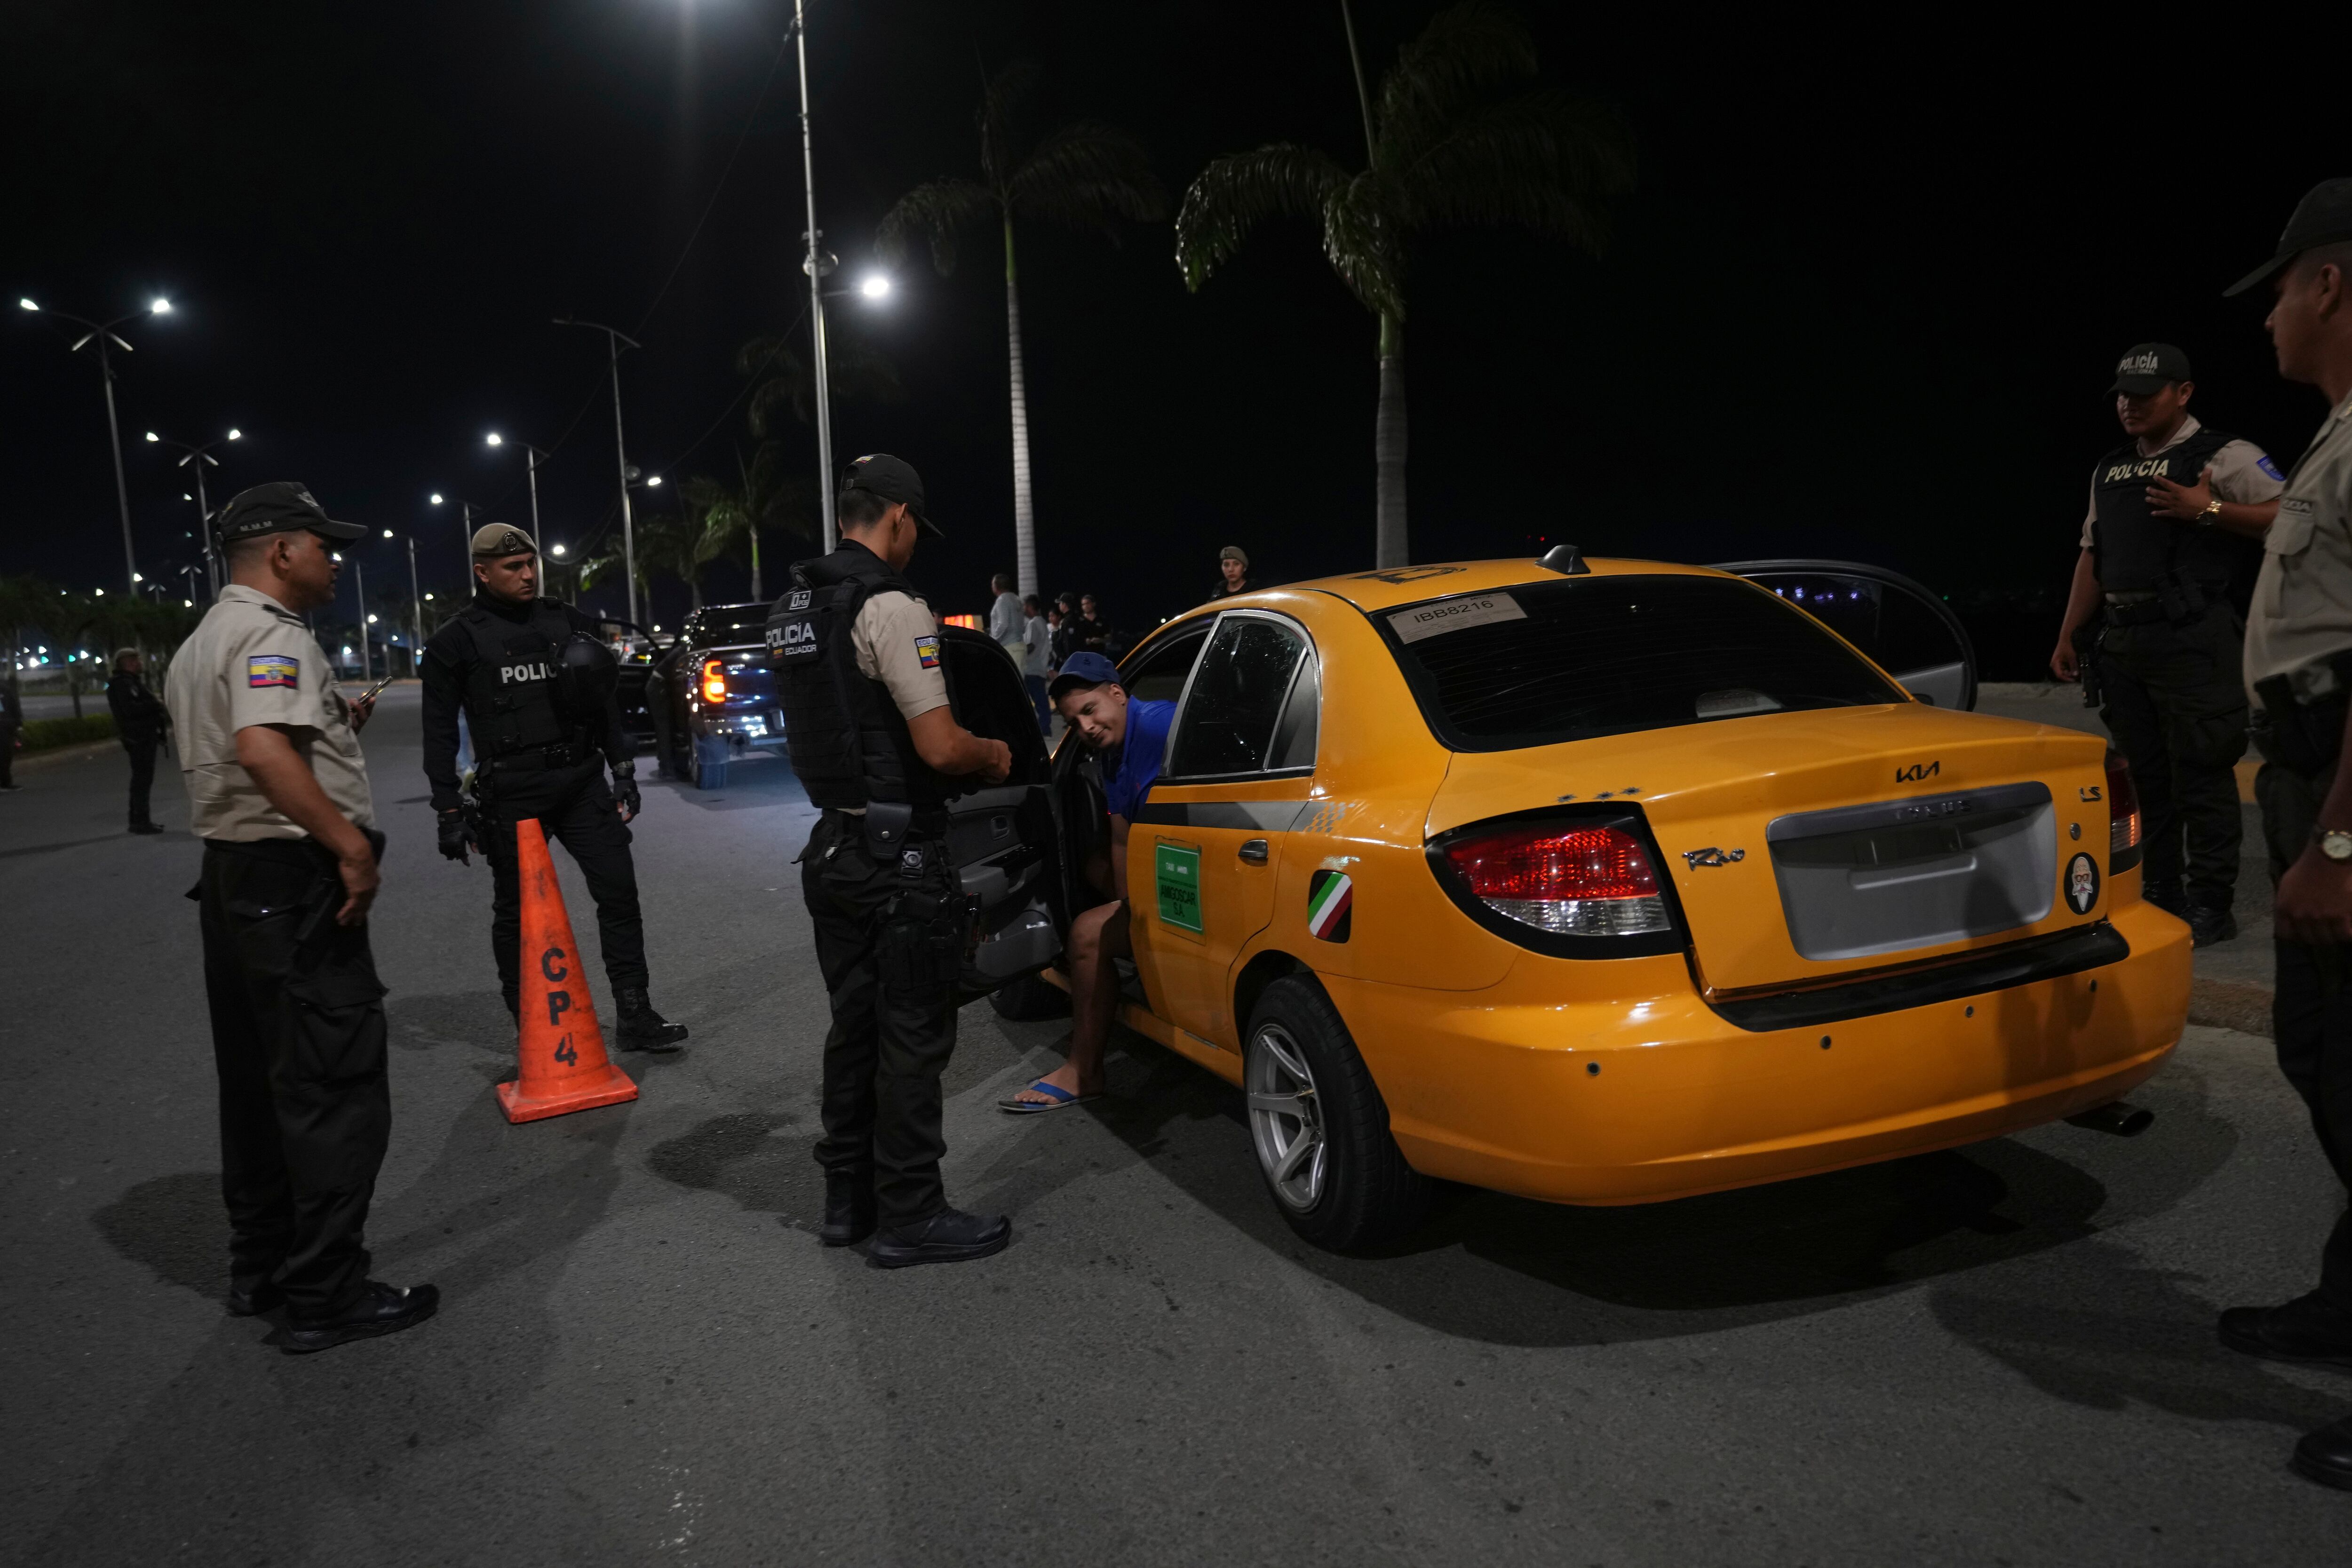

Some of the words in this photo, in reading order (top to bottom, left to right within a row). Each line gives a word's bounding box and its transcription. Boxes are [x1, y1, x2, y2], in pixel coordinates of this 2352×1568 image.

[1413, 601, 1494, 623] IBB8216
[766, 622, 816, 650] POLICÍA
[785, 645, 817, 655] ECUADOR
[501, 662, 557, 684] POLIC
[1896, 761, 1939, 783] KIA
[2078, 786, 2102, 802] LS
[1682, 847, 1745, 871] Rio
